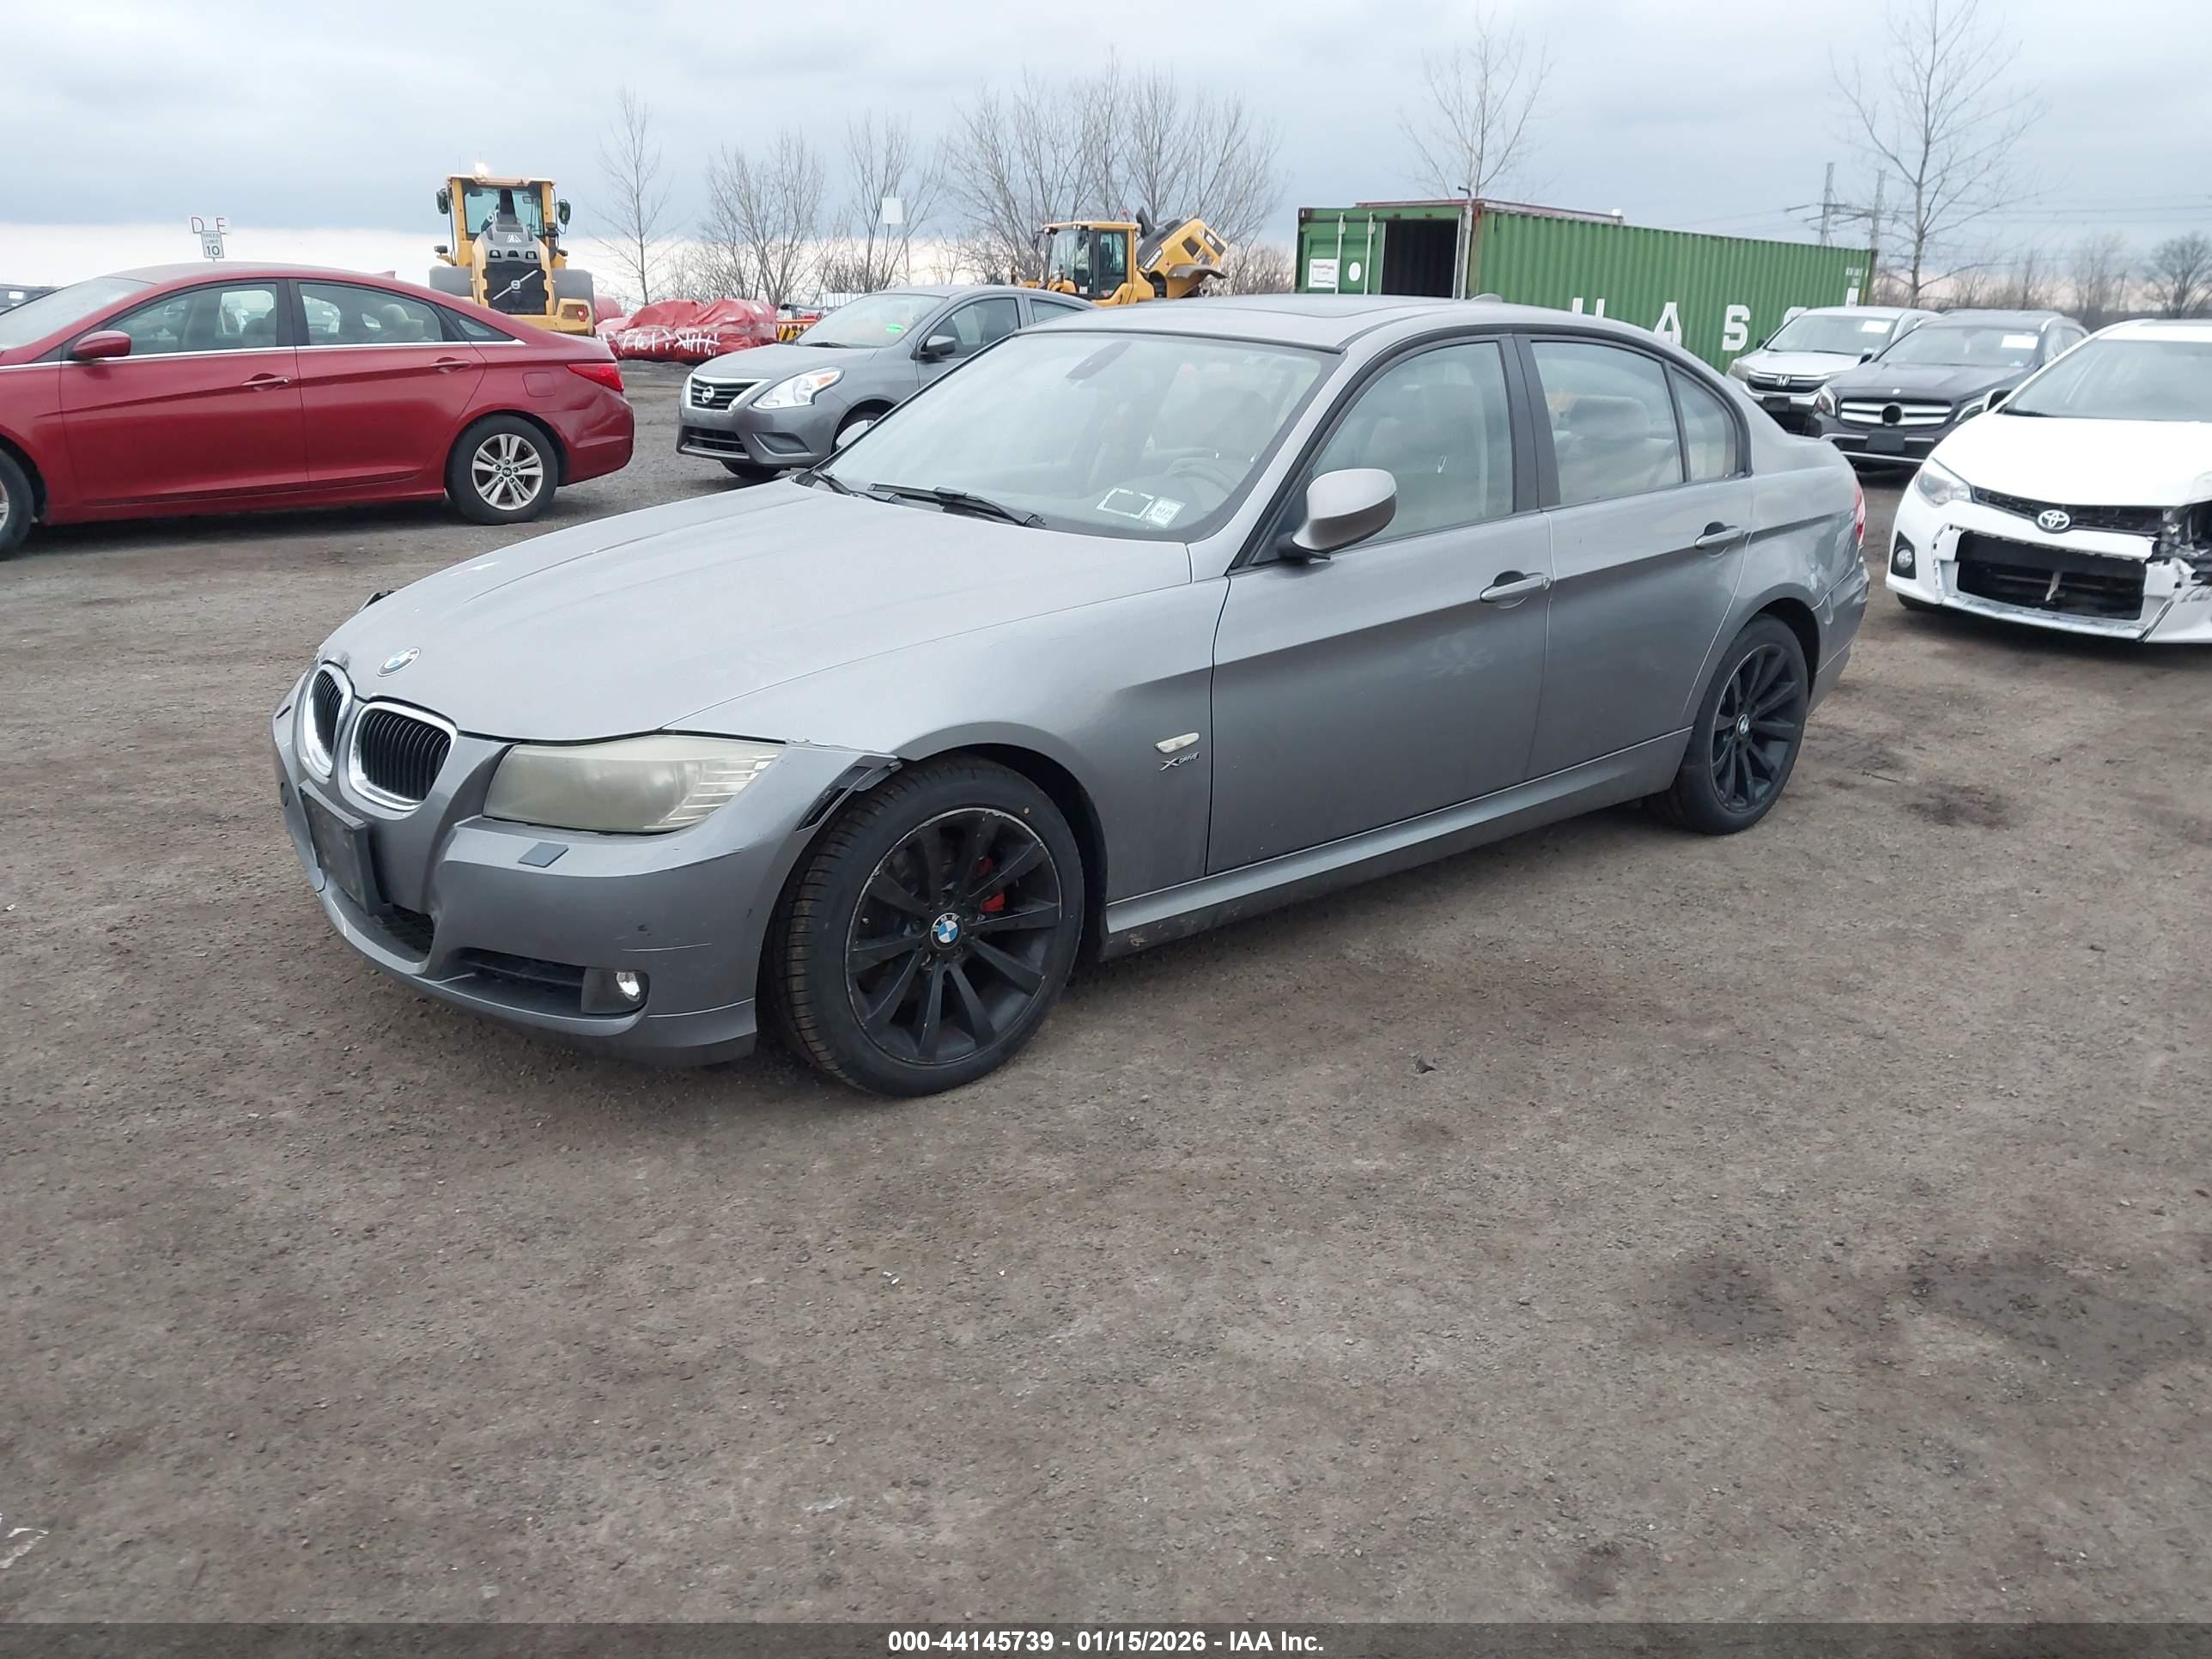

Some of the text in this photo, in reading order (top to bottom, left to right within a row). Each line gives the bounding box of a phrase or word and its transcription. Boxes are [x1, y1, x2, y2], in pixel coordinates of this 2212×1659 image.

[191, 216, 227, 234] D E
[206, 246, 220, 255] 10
[932, 913, 960, 933] BMW
